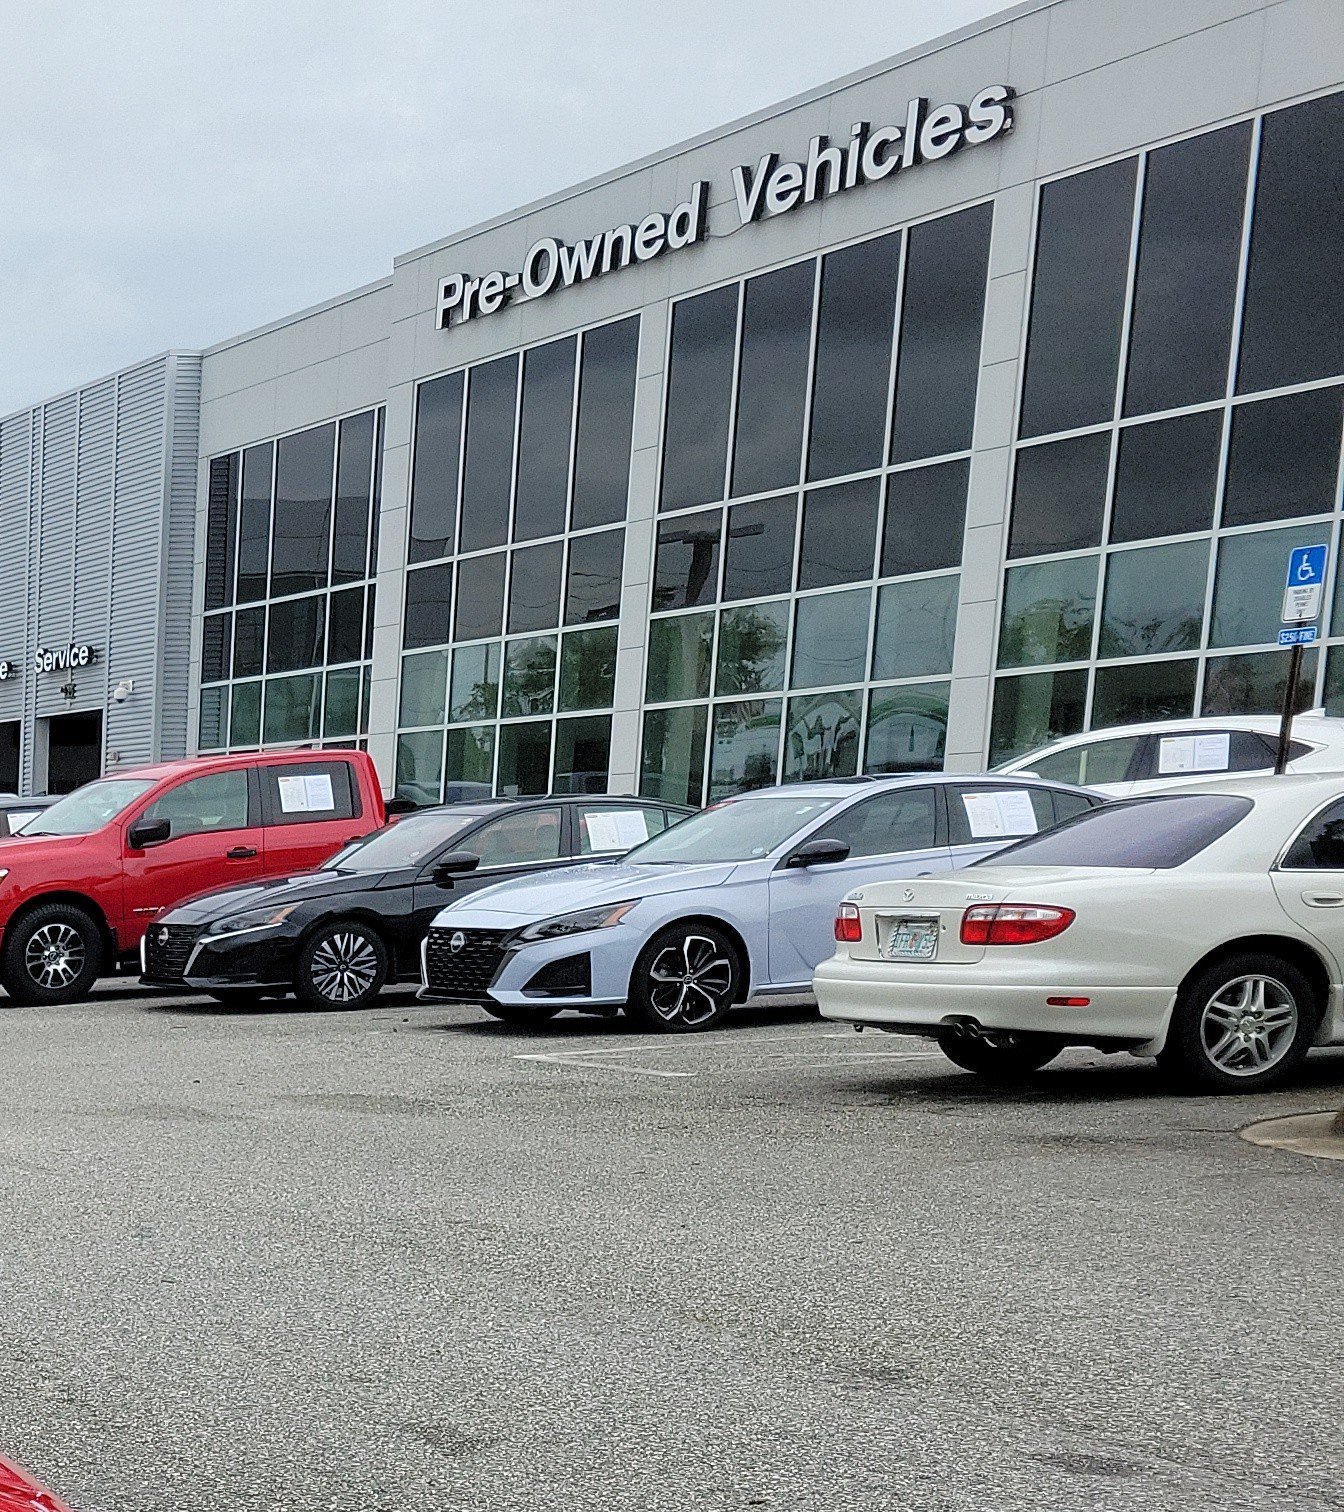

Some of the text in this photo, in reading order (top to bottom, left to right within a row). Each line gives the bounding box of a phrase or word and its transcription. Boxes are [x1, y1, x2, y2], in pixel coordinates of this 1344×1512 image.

[434, 85, 1014, 330] Pre-Owned Vehicles
[34, 643, 93, 674] Service
